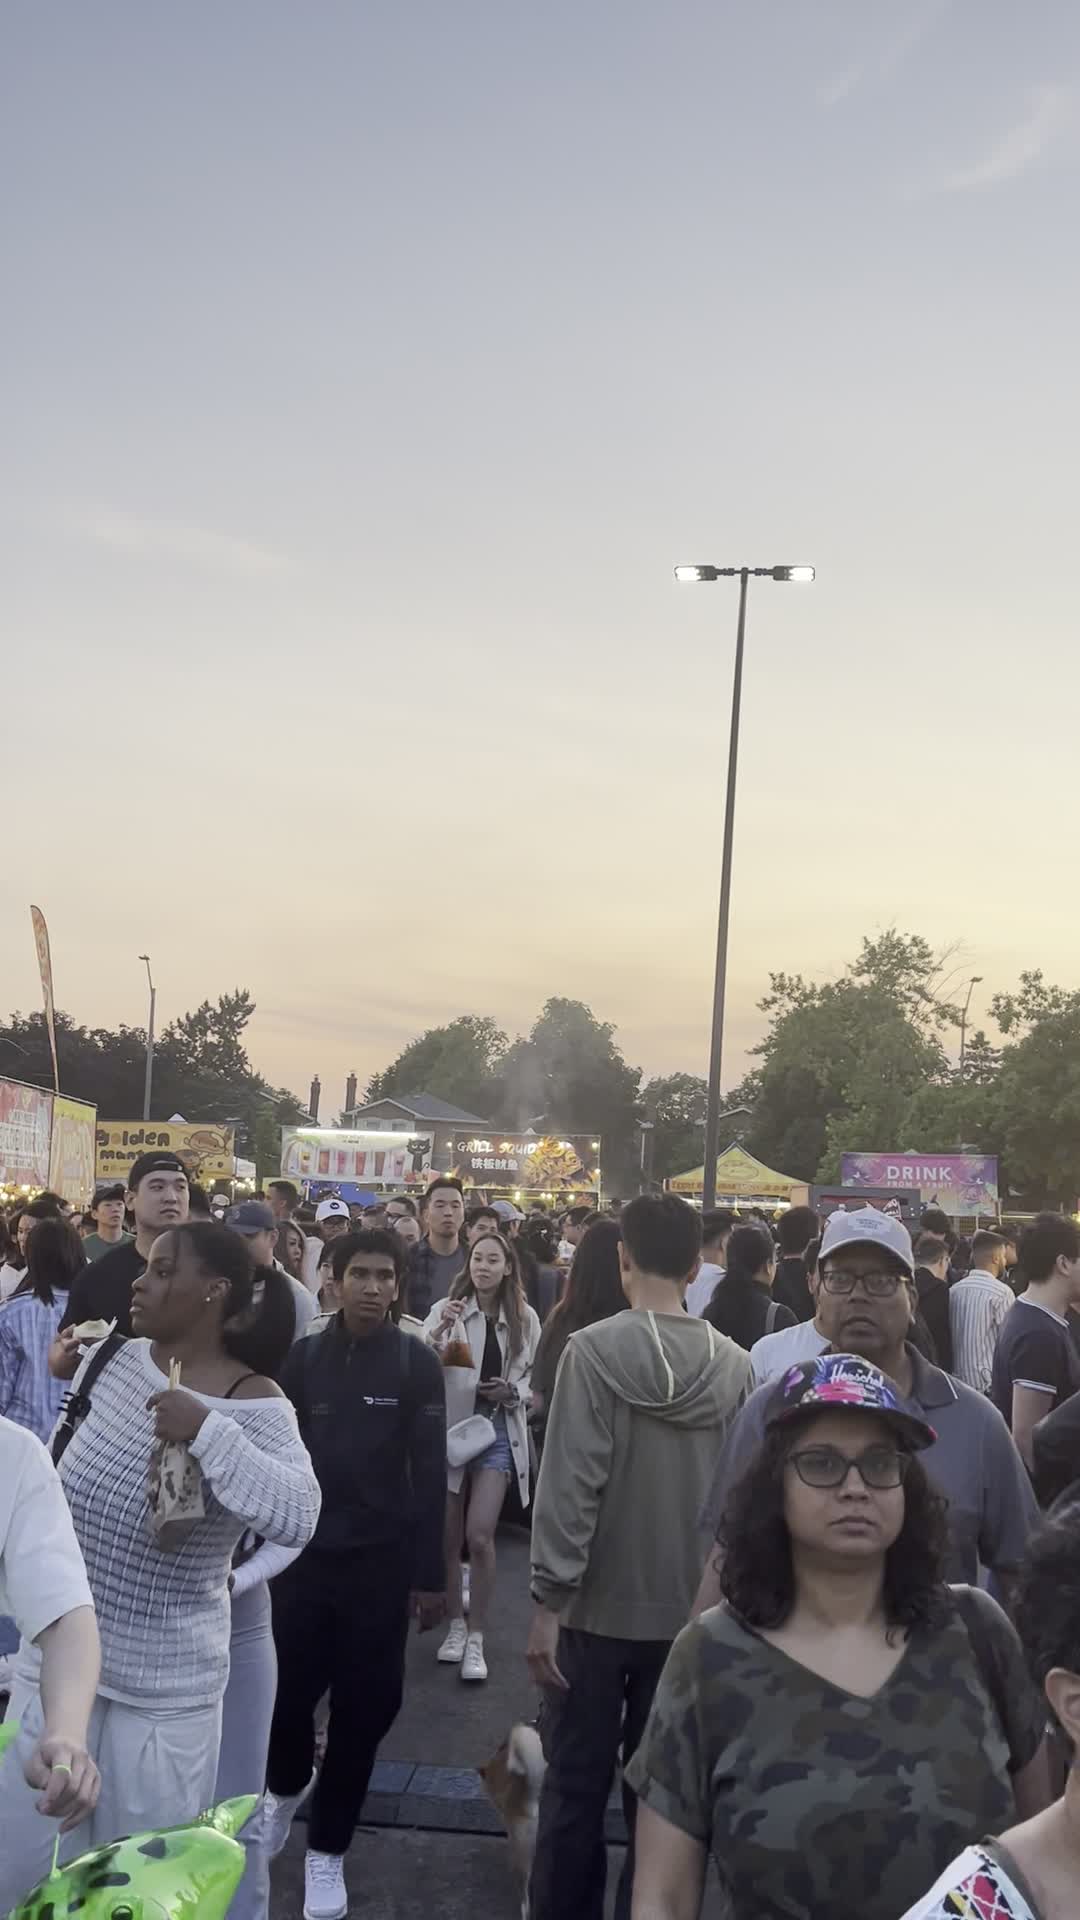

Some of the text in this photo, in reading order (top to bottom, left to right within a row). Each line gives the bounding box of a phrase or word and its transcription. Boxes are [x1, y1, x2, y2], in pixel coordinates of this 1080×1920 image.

[457, 1139, 538, 1155] GRILL SQUID
[887, 1165, 952, 1181] DRINK
